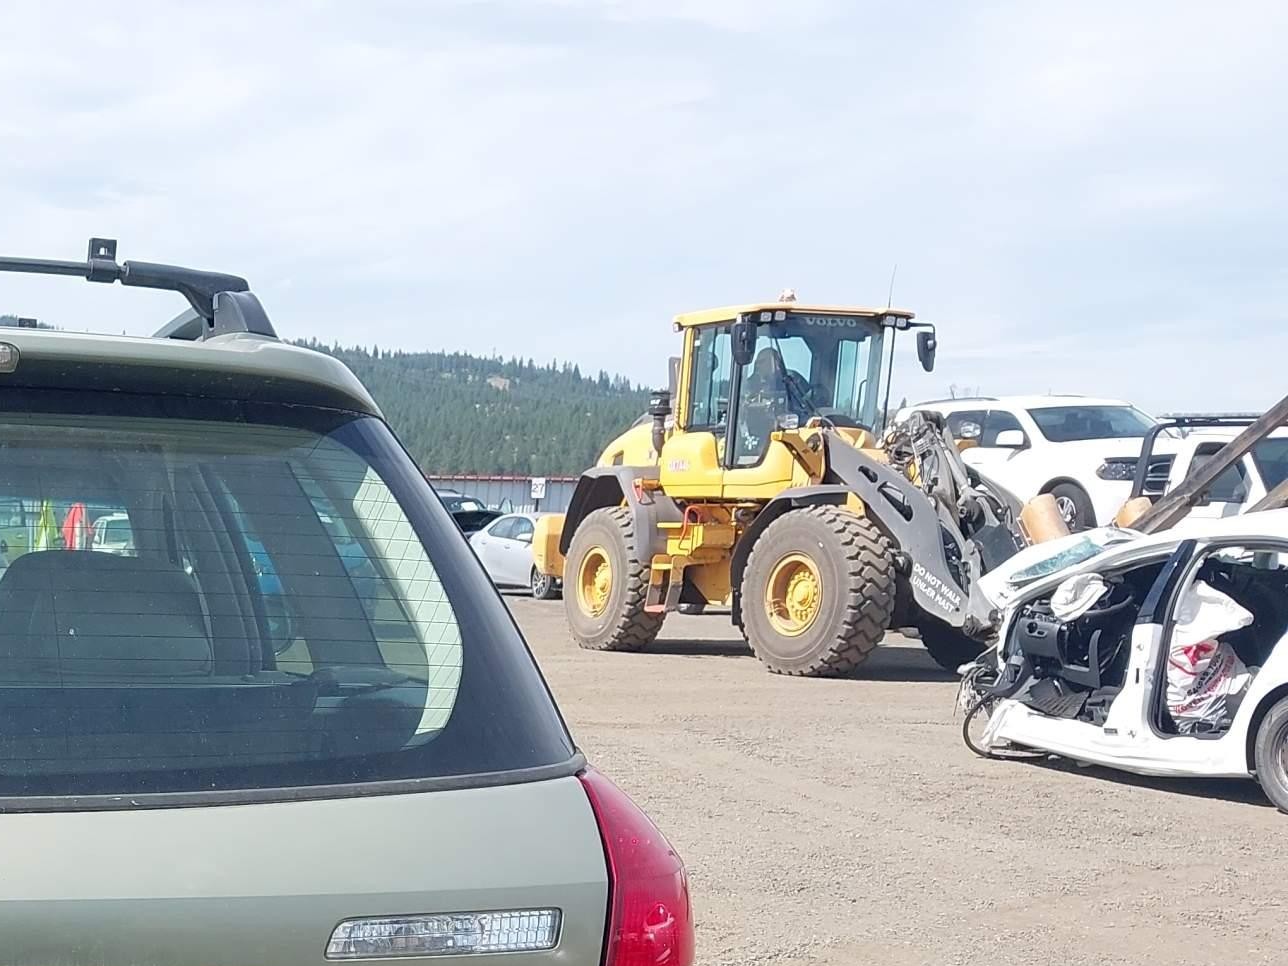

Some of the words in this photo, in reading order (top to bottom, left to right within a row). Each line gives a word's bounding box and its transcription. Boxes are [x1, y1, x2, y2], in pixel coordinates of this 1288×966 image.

[805, 316, 857, 328] VOLVO
[532, 482, 545, 493] 27
[913, 563, 925, 576] DO
[925, 571, 942, 588] NOT
[940, 583, 961, 606] WALK
[934, 593, 955, 613] MAST
